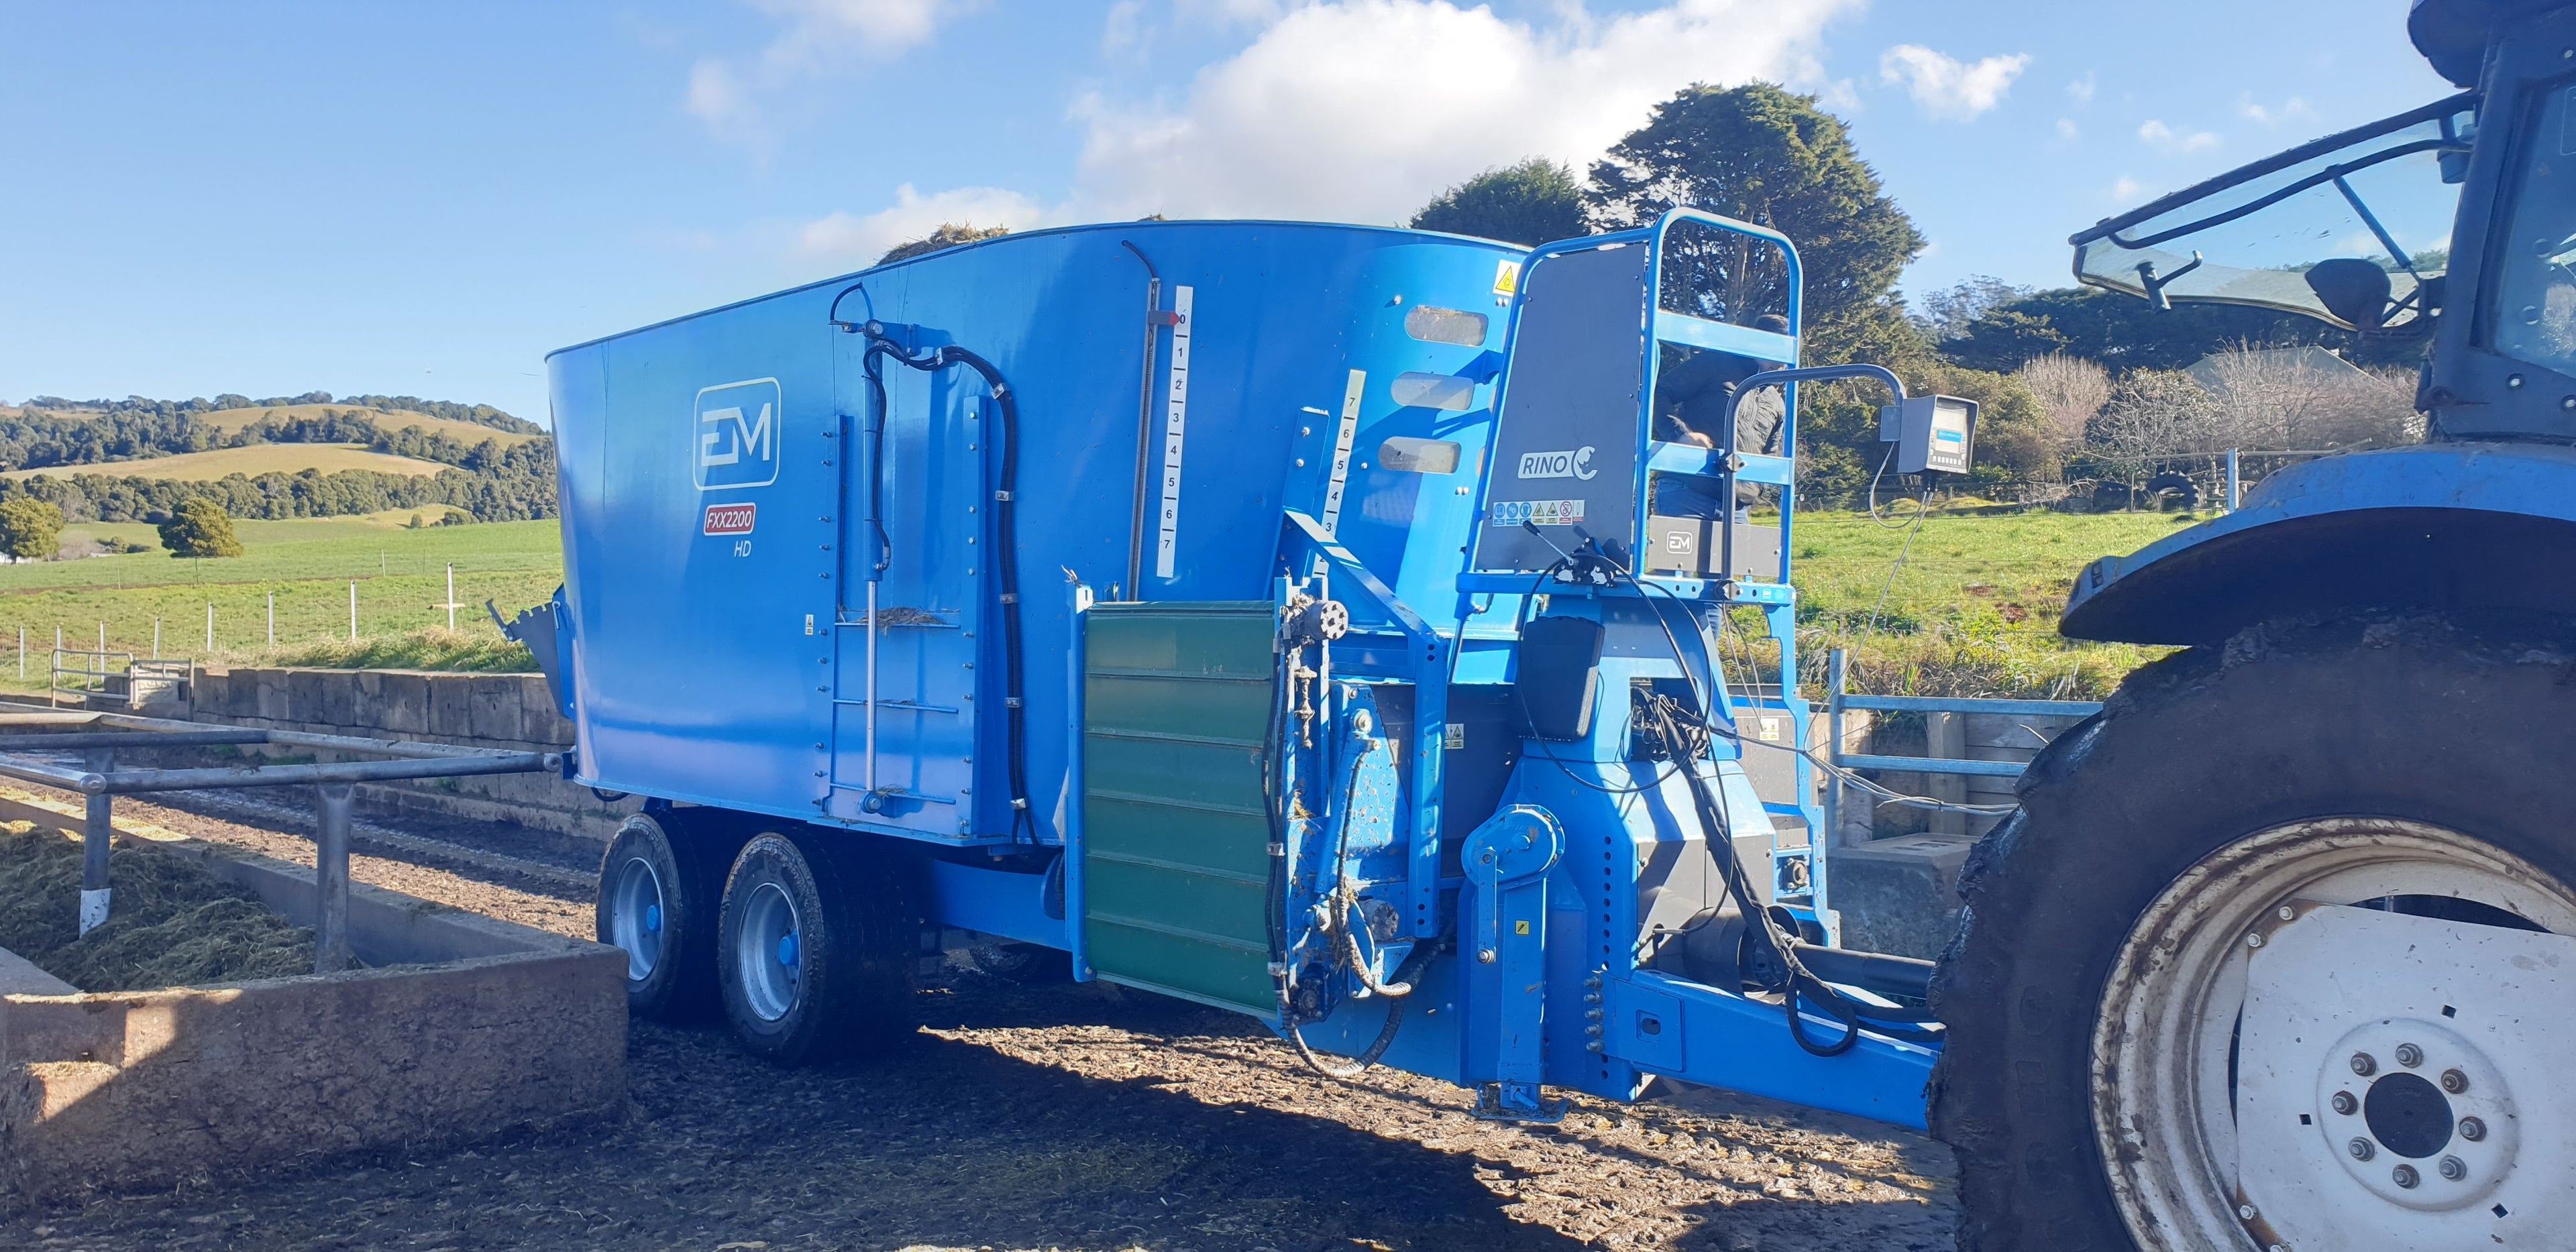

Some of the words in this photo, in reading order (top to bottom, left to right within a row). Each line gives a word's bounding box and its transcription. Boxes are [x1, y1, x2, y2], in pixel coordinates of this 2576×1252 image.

[1179, 314, 1185, 325] 0
[1178, 347, 1183, 357] 1
[1175, 379, 1183, 390] 2
[1349, 397, 1356, 407] 7
[1173, 412, 1179, 423] 3
[701, 402, 771, 467] EM
[1343, 429, 1350, 439] 6
[1170, 445, 1177, 455] 4
[1337, 460, 1344, 470] 5
[1523, 455, 1568, 474] RINO
[1168, 477, 1175, 487] 5
[1331, 492, 1338, 501] 4
[706, 510, 752, 528] FXX2200
[1166, 509, 1173, 519] 6
[1325, 522, 1332, 532] 3
[1164, 539, 1171, 549] 7
[1670, 536, 1690, 550] EM
[734, 540, 752, 557] HD
